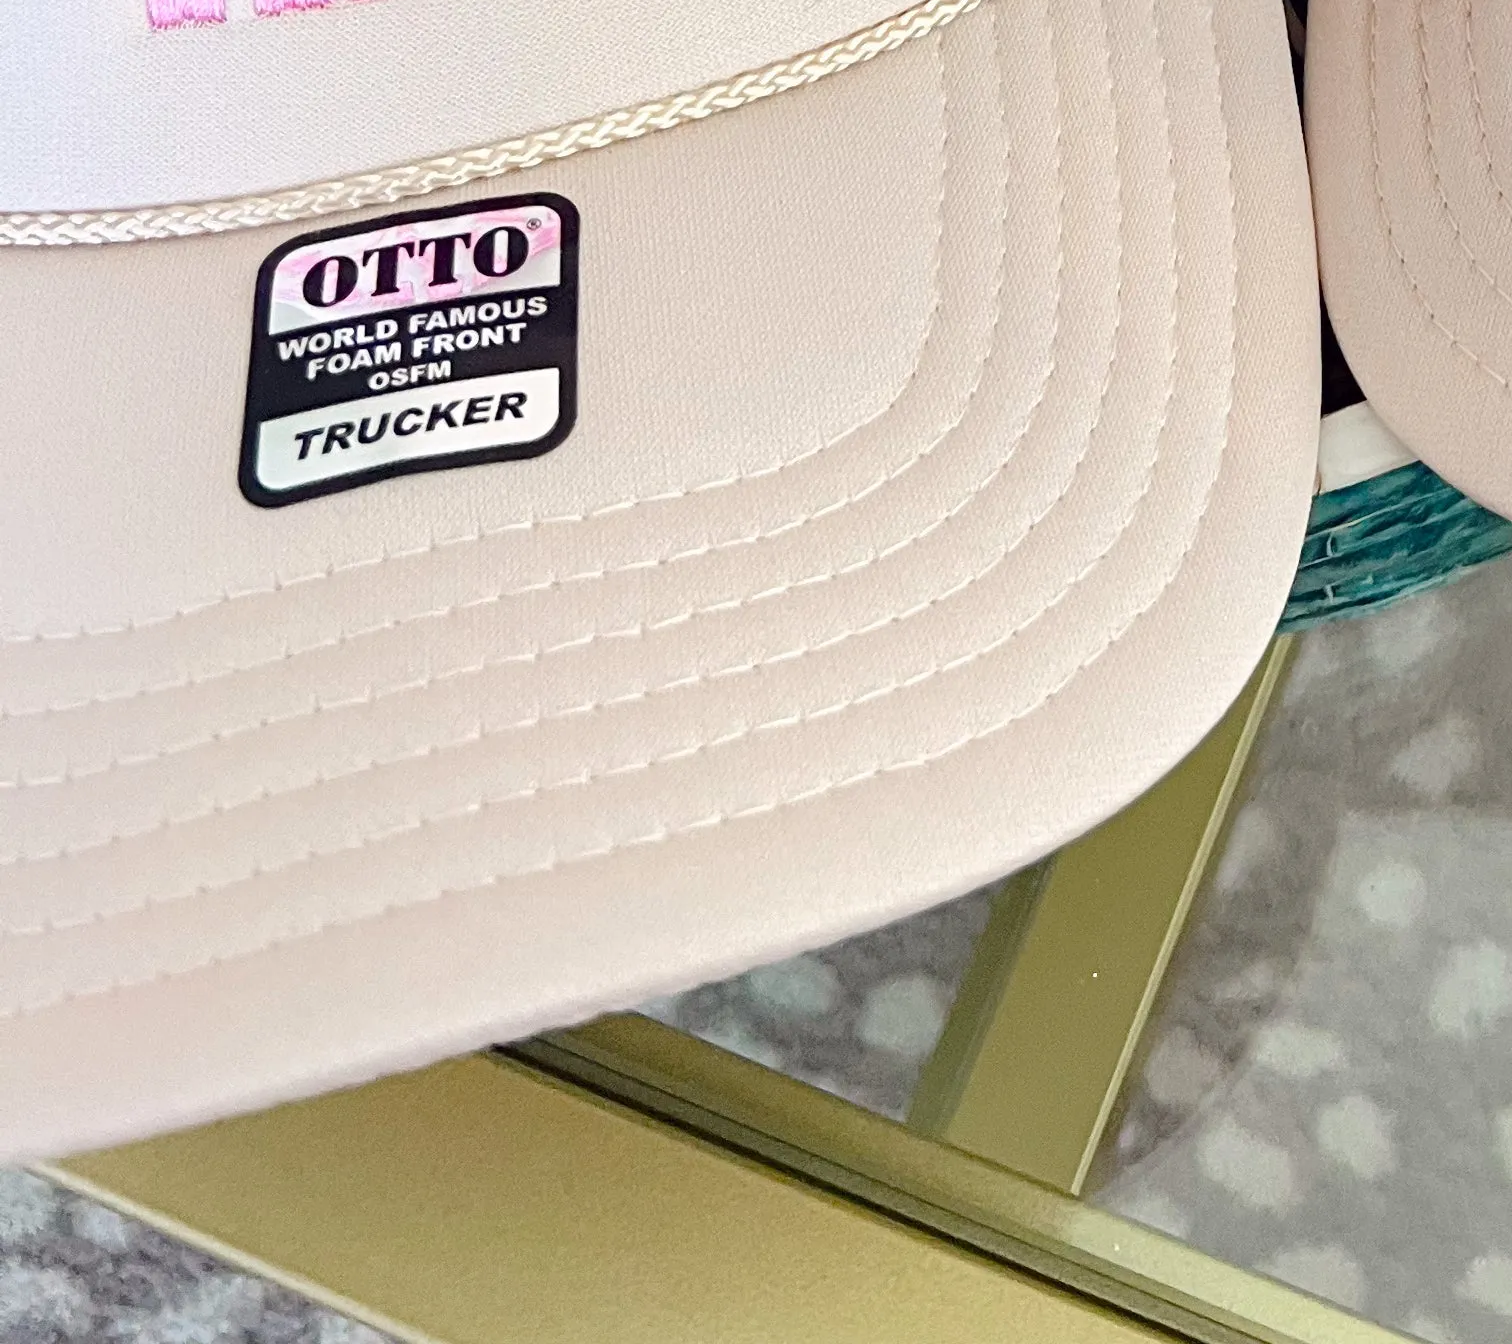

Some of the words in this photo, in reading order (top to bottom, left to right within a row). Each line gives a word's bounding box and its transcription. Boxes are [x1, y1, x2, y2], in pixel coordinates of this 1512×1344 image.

[277, 319, 399, 362] WORLD
[408, 295, 549, 334] FAMOUS
[305, 342, 401, 381] FOAM
[411, 322, 527, 358] FRONT
[367, 360, 452, 391] OSFM
[294, 392, 528, 461] TRUCKER
